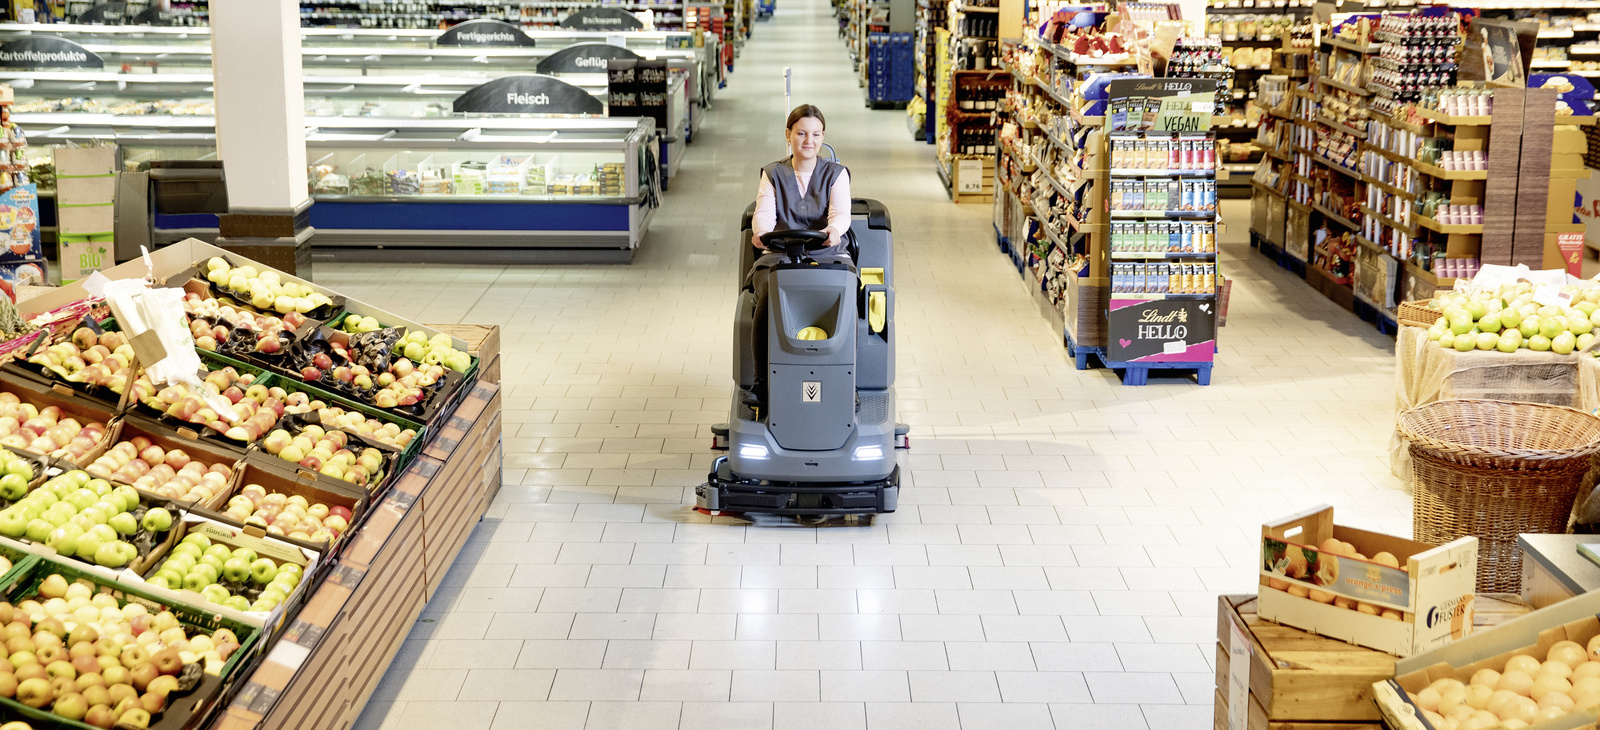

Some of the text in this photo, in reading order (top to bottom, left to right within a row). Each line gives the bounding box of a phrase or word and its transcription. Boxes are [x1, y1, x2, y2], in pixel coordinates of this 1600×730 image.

[457, 32, 515, 43] Fertiggerichte
[575, 57, 609, 69] Geflüg
[1134, 82, 1192, 91] Lindt HELLO
[506, 92, 550, 105] Fleisch
[1165, 101, 1192, 110] HELL
[1164, 116, 1200, 131] VEGAN
[80, 253, 101, 268] BIO
[1138, 309, 1178, 323] Lindt
[1137, 325, 1188, 340] HELLO
[1345, 577, 1402, 595] orange-x-press
[1439, 603, 1466, 624] FUSTER
